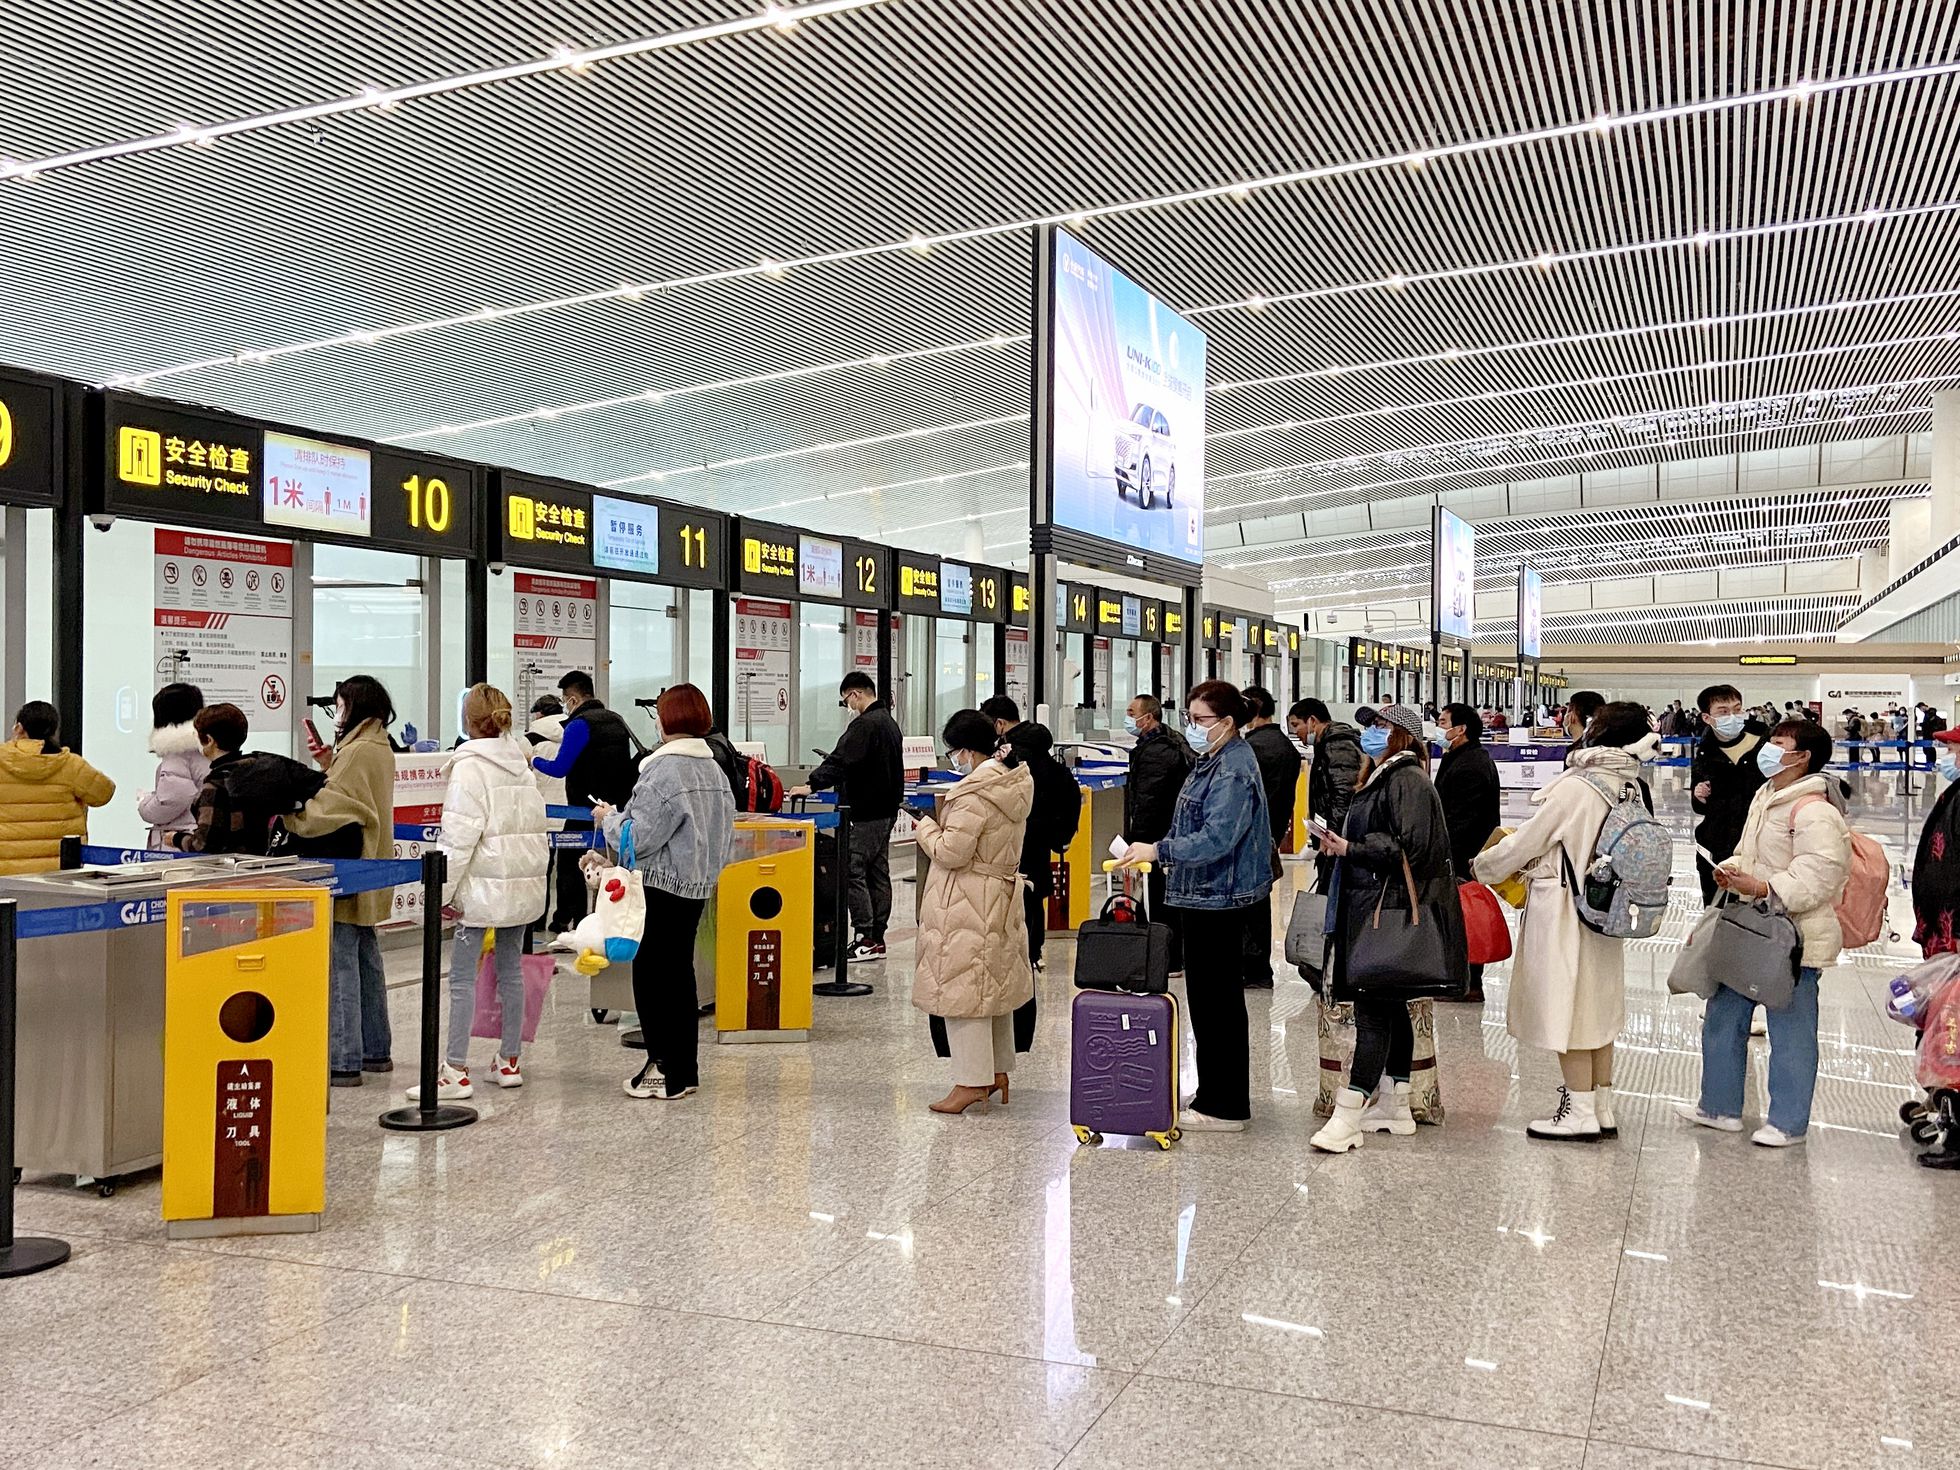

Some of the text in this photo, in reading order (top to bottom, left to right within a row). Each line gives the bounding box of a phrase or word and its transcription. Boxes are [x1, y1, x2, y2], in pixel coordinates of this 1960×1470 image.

[164, 435, 250, 474] 安全检查
[165, 470, 249, 495] Security Check
[269, 476, 304, 509] 1米
[402, 474, 449, 532] 10
[534, 501, 586, 529] 安全检查
[535, 527, 586, 546] Security Check
[610, 520, 643, 537] 暂停服务
[680, 524, 705, 568] 11
[761, 542, 795, 564] 安全检查
[761, 562, 795, 577] Security Check
[856, 556, 876, 593] 12
[980, 577, 996, 609] 13
[1073, 594, 1087, 622] 14
[1145, 606, 1156, 632] 15
[1203, 616, 1213, 639] 16
[1250, 625, 1259, 646] 17
[120, 901, 147, 925] GA
[226, 1097, 261, 1110] 液体
[226, 1125, 260, 1139] 刀具
